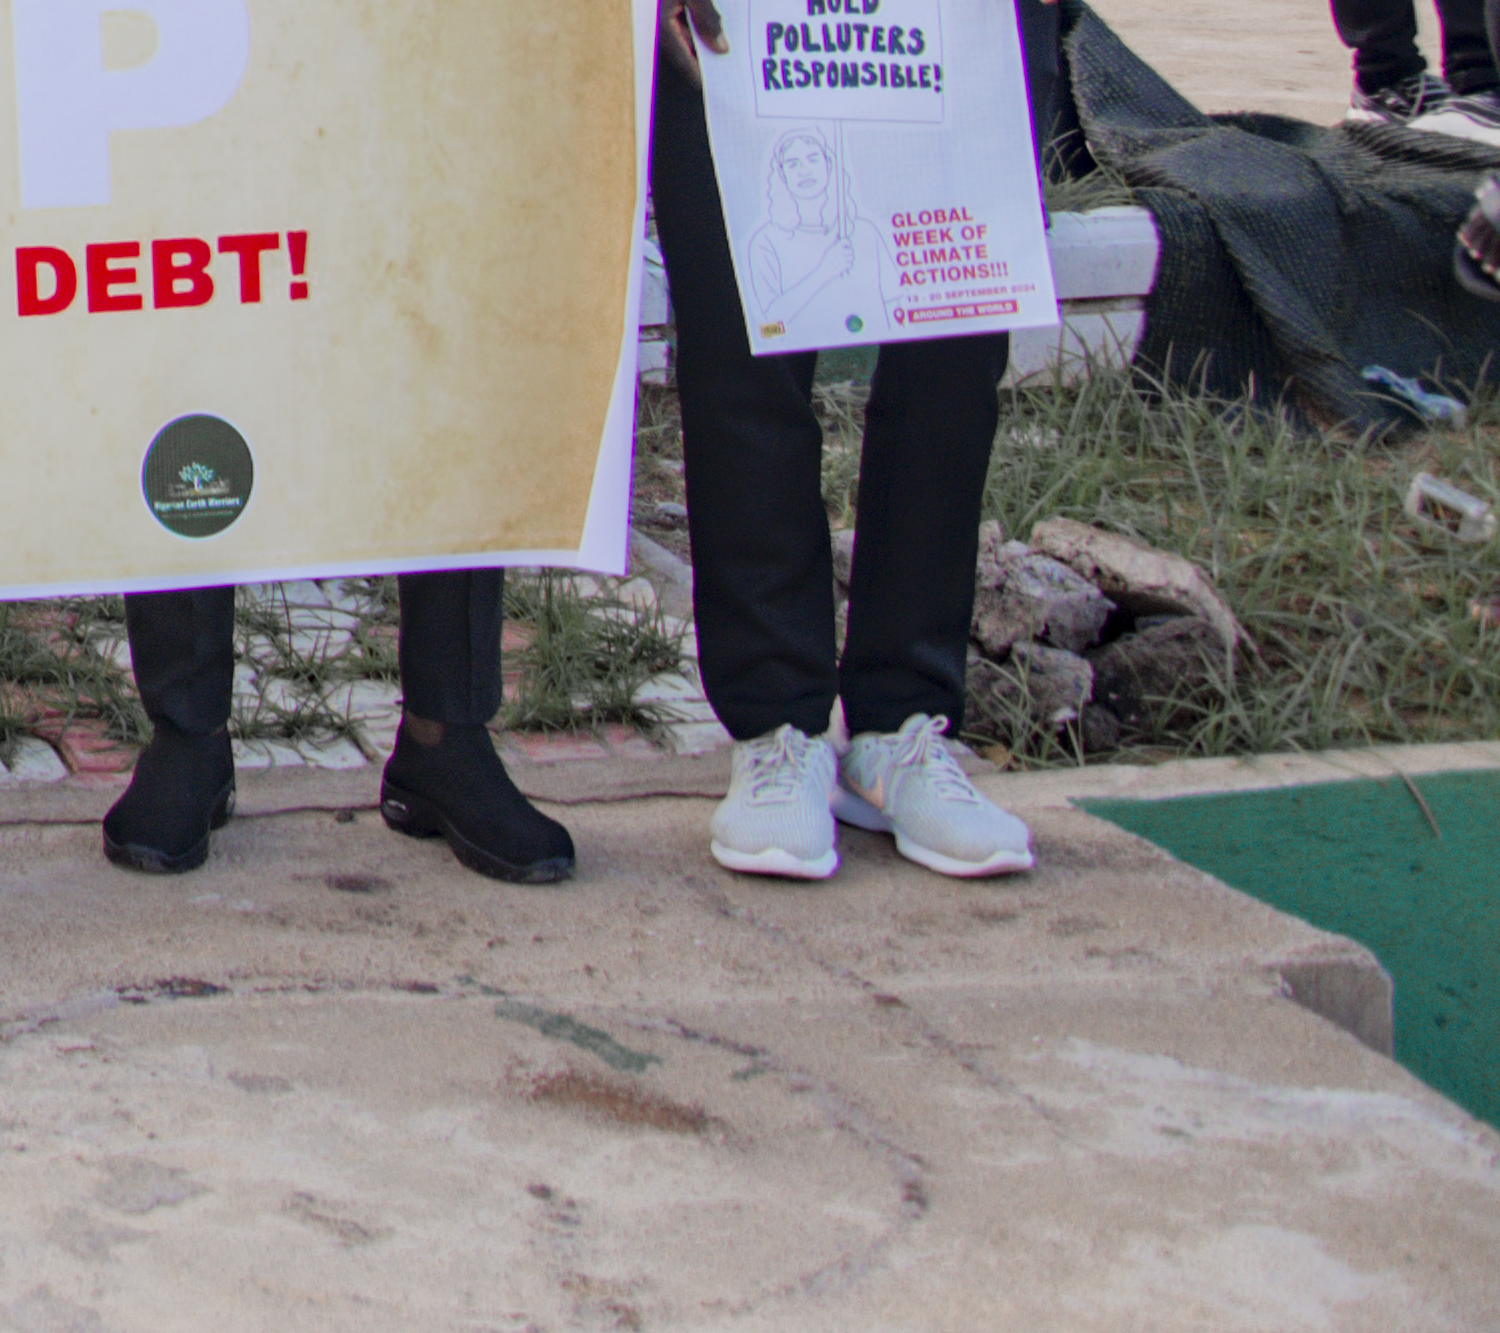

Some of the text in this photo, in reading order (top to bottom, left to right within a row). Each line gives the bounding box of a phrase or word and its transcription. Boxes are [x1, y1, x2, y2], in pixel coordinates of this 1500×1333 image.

[767, 22, 925, 56] POLLUTERS
[761, 58, 943, 92] RESPONSIBLE!
[892, 206, 973, 228] GLOBAL
[893, 224, 987, 247] WEEK OF
[896, 244, 988, 267] CLIMATE
[13, 230, 312, 318] DEBT!
[900, 261, 1008, 286] ACTIONS!!!
[945, 286, 1007, 299] SEPTEMBER
